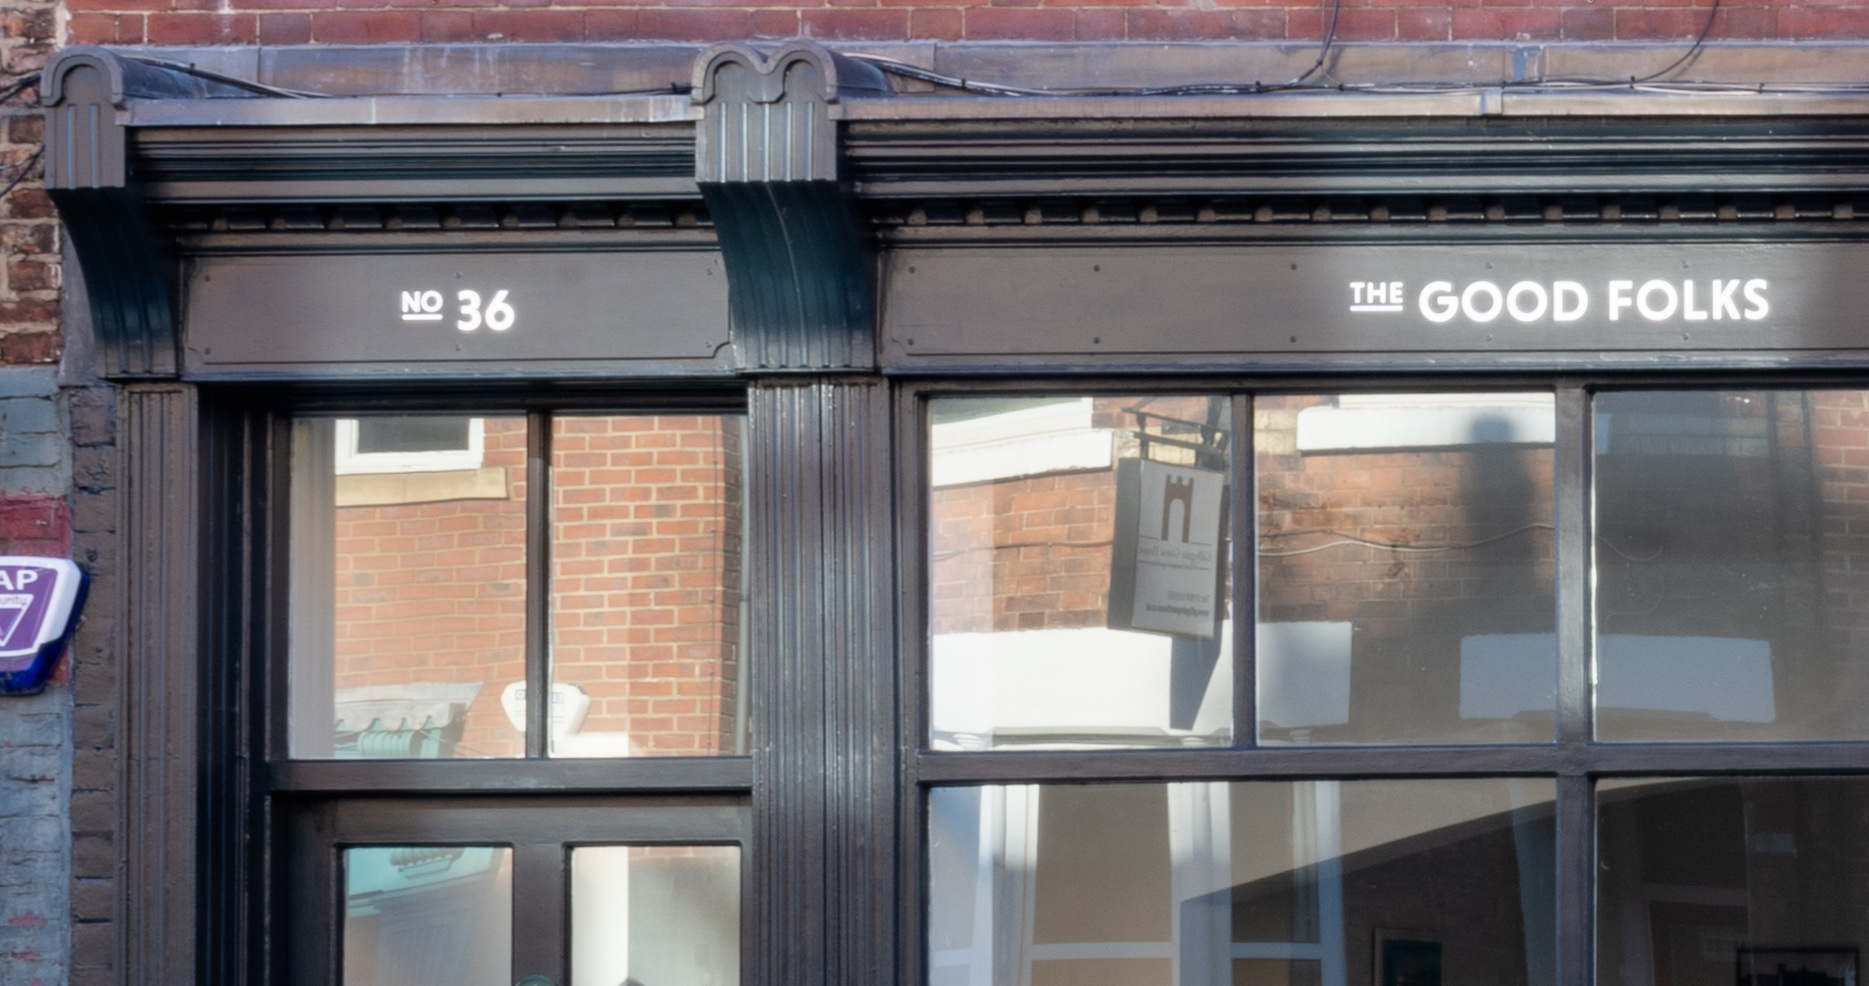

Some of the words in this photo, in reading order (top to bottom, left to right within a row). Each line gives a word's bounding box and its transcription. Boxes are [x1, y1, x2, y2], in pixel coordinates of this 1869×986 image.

[457, 289, 516, 331] 36
[1349, 281, 1404, 305] THE
[1418, 280, 1588, 322] GOOD
[1608, 278, 1769, 321] FOLKS
